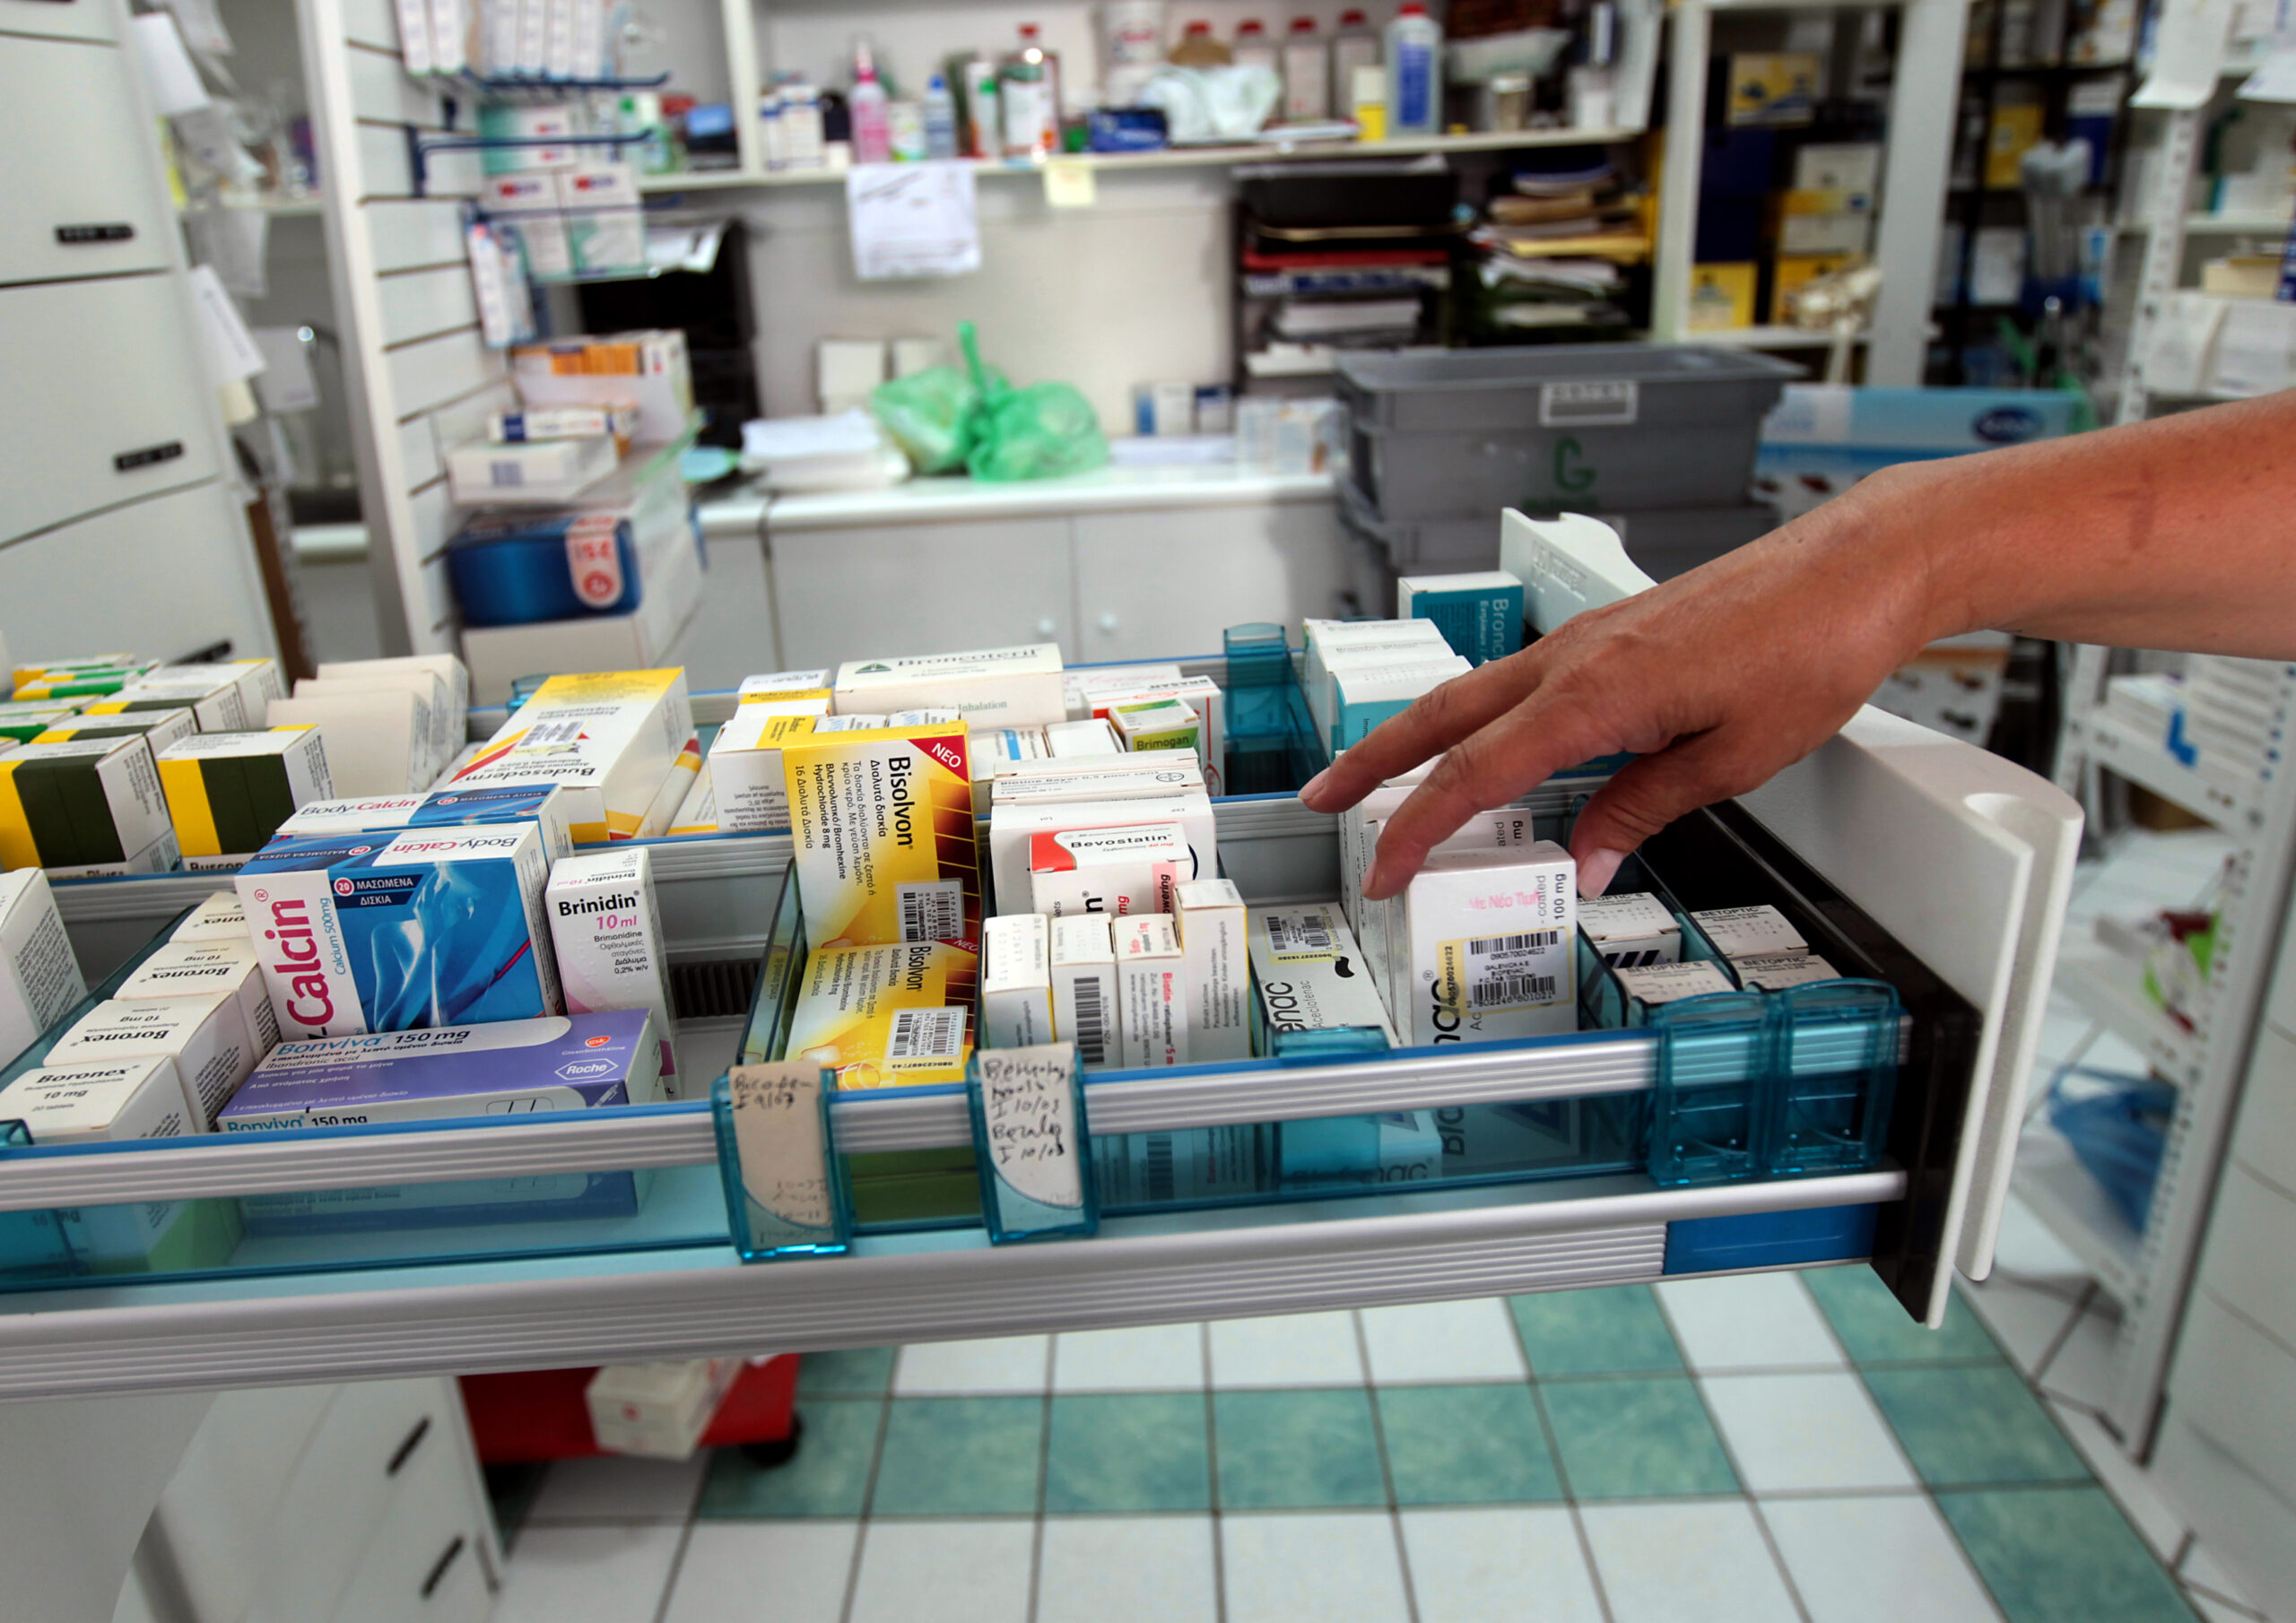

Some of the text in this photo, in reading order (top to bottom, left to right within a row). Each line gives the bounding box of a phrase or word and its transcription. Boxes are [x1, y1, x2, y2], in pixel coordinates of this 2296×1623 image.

[853, 761, 862, 771] Τα
[932, 742, 961, 768] NEO
[841, 762, 853, 785] κρύο
[848, 813, 857, 825] Με
[856, 774, 865, 802] δισκία
[871, 760, 887, 838] Διαλυτά δισκία
[796, 766, 814, 849] 16 Διαλυτά Δισκία
[813, 764, 831, 826] Hydrochloride
[822, 836, 831, 848] mg
[889, 757, 915, 846] Bisolvon
[858, 803, 869, 849] διαλύονται
[1494, 820, 1505, 847] ated
[1071, 836, 1168, 847] Bevostatin
[864, 853, 871, 862] σε
[356, 876, 414, 890] ΜΑΣΩΜΕΝΑ
[360, 894, 392, 906] ΔΙΣΚΙΑ
[559, 893, 636, 916] Brinidin
[1553, 873, 1566, 920] 100 mg
[596, 915, 638, 930] 10 ml
[319, 898, 347, 975] Calcium 500mg
[594, 932, 643, 942] Brimonidine
[615, 956, 647, 966] Διάλυμα
[906, 946, 932, 990] Bisolvon
[148, 968, 230, 980] Boronex
[1265, 982, 1306, 1031] enac
[1300, 980, 1324, 1028] Aceclofenac
[80, 1030, 170, 1043] Boronex
[275, 1029, 472, 1055] Bonviva 150 mg
[265, 1055, 361, 1069] Ibandronic acid
[566, 1063, 608, 1075] Roche
[37, 1069, 129, 1083] Boronex
[44, 1091, 61, 1099] 10
